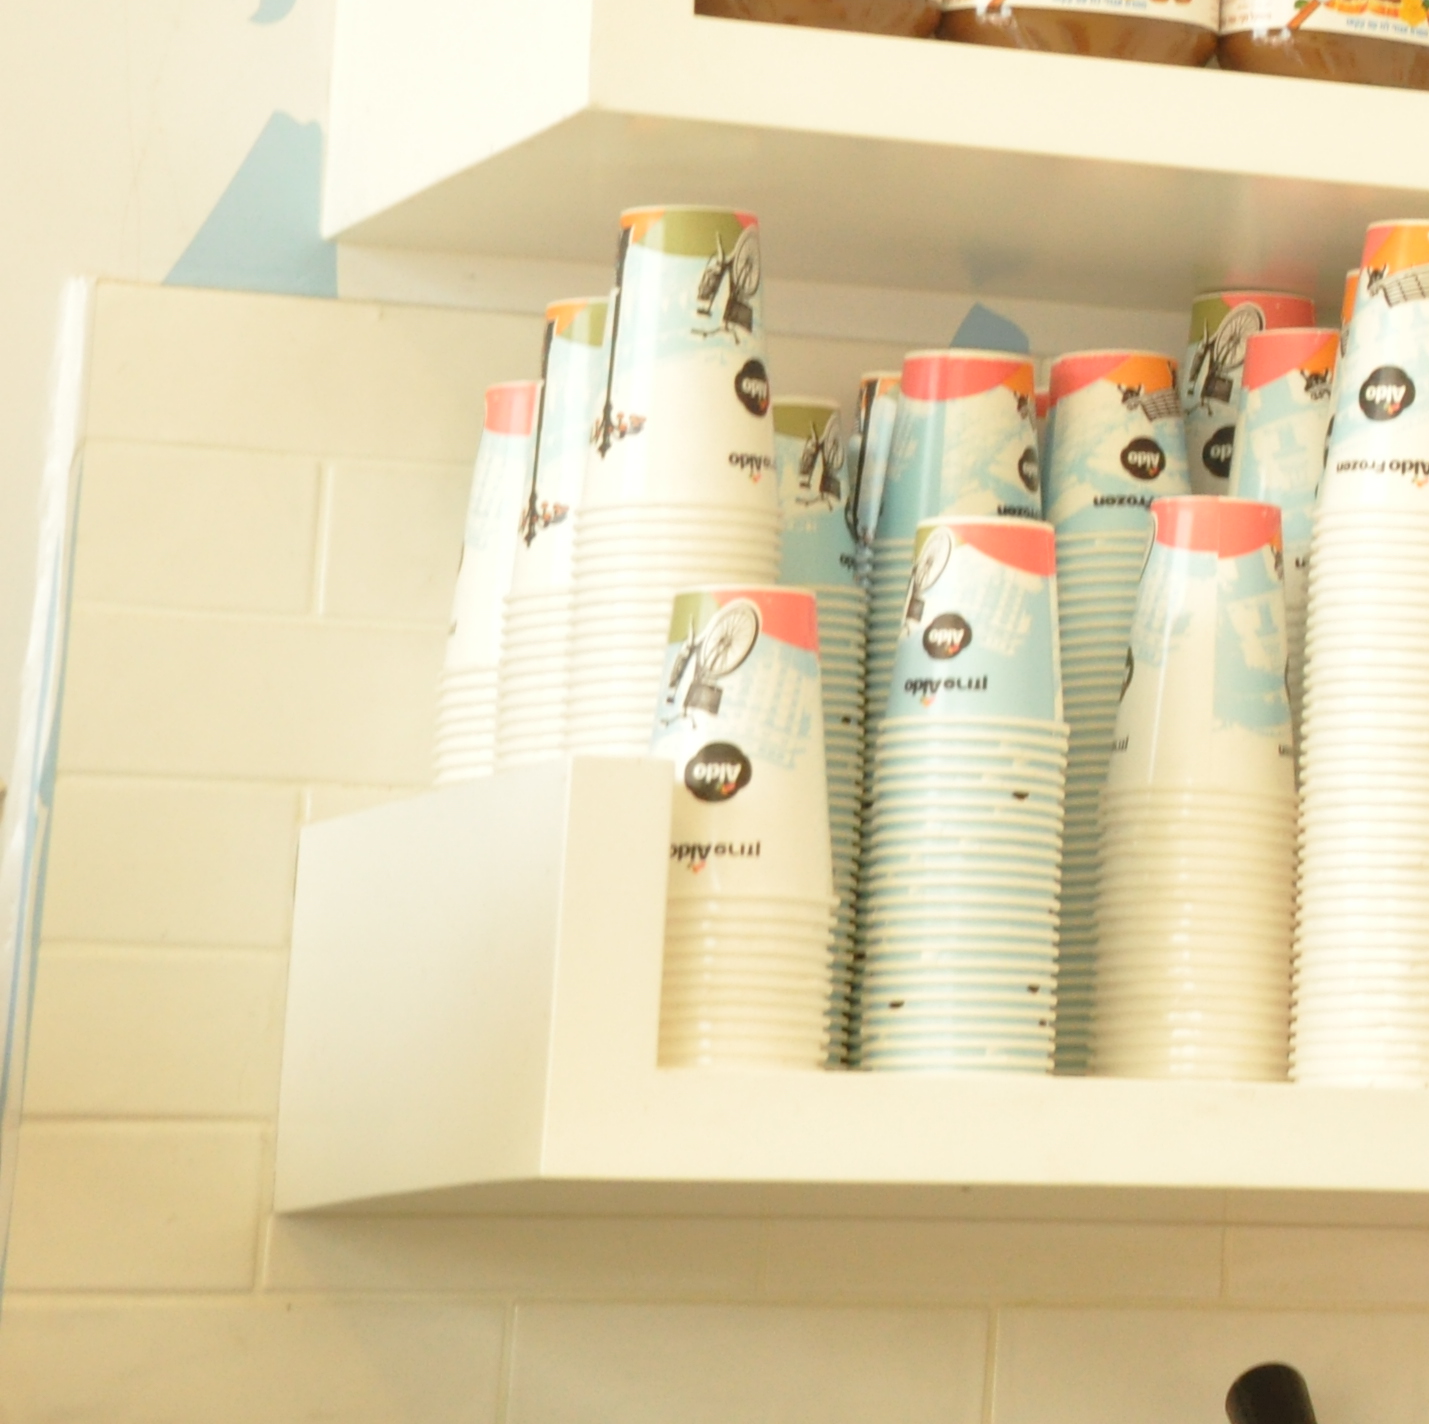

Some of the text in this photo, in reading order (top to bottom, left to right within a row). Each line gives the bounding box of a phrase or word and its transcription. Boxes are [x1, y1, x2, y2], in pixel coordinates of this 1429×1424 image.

[1365, 384, 1407, 404] Aldo
[1127, 450, 1161, 469] Aldo
[1210, 444, 1233, 460] do
[1336, 460, 1386, 474] Frozen
[928, 628, 965, 647] Aldo
[904, 678, 942, 697] Aldo
[692, 763, 742, 784] Aldo
[714, 841, 761, 860] פרוזן
